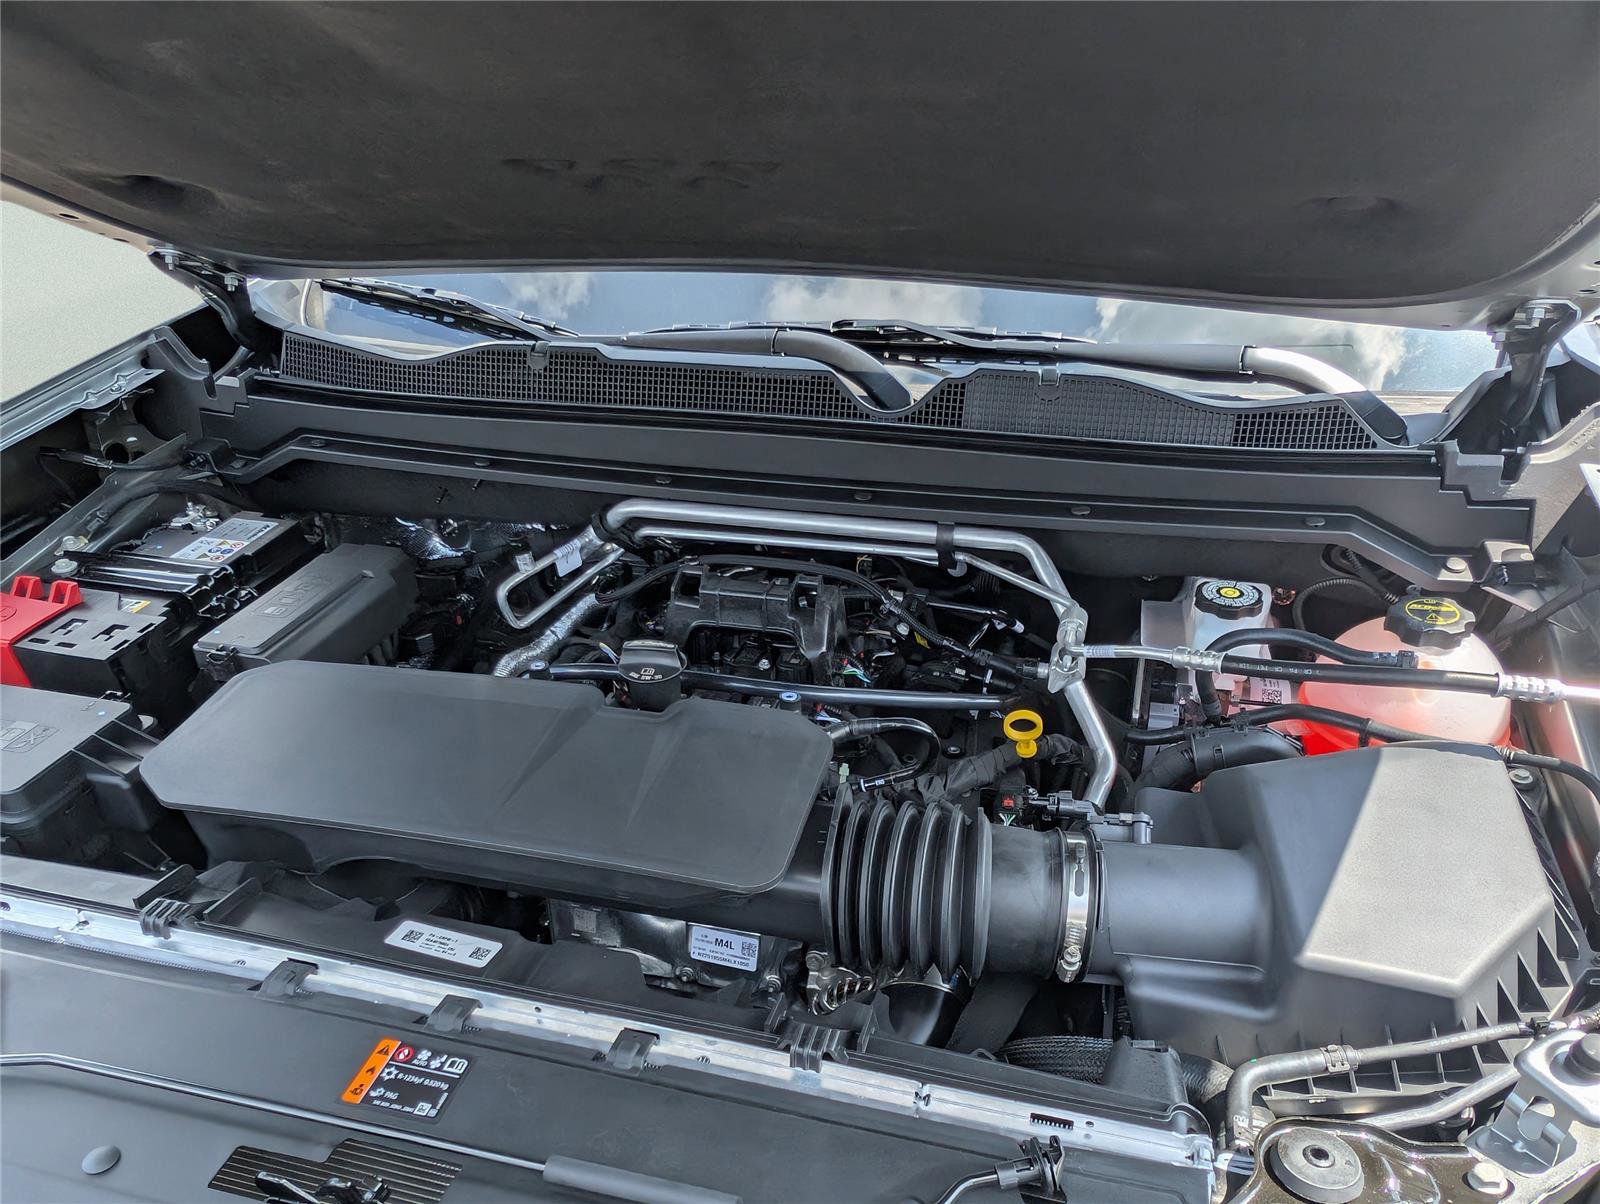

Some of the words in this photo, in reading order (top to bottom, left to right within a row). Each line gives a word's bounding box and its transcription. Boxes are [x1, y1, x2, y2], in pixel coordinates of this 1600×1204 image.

[714, 937, 735, 950] M4L
[411, 1058, 428, 1067] AUTO
[396, 1072, 424, 1085] R-1234yf
[383, 1090, 399, 1100] PAG
